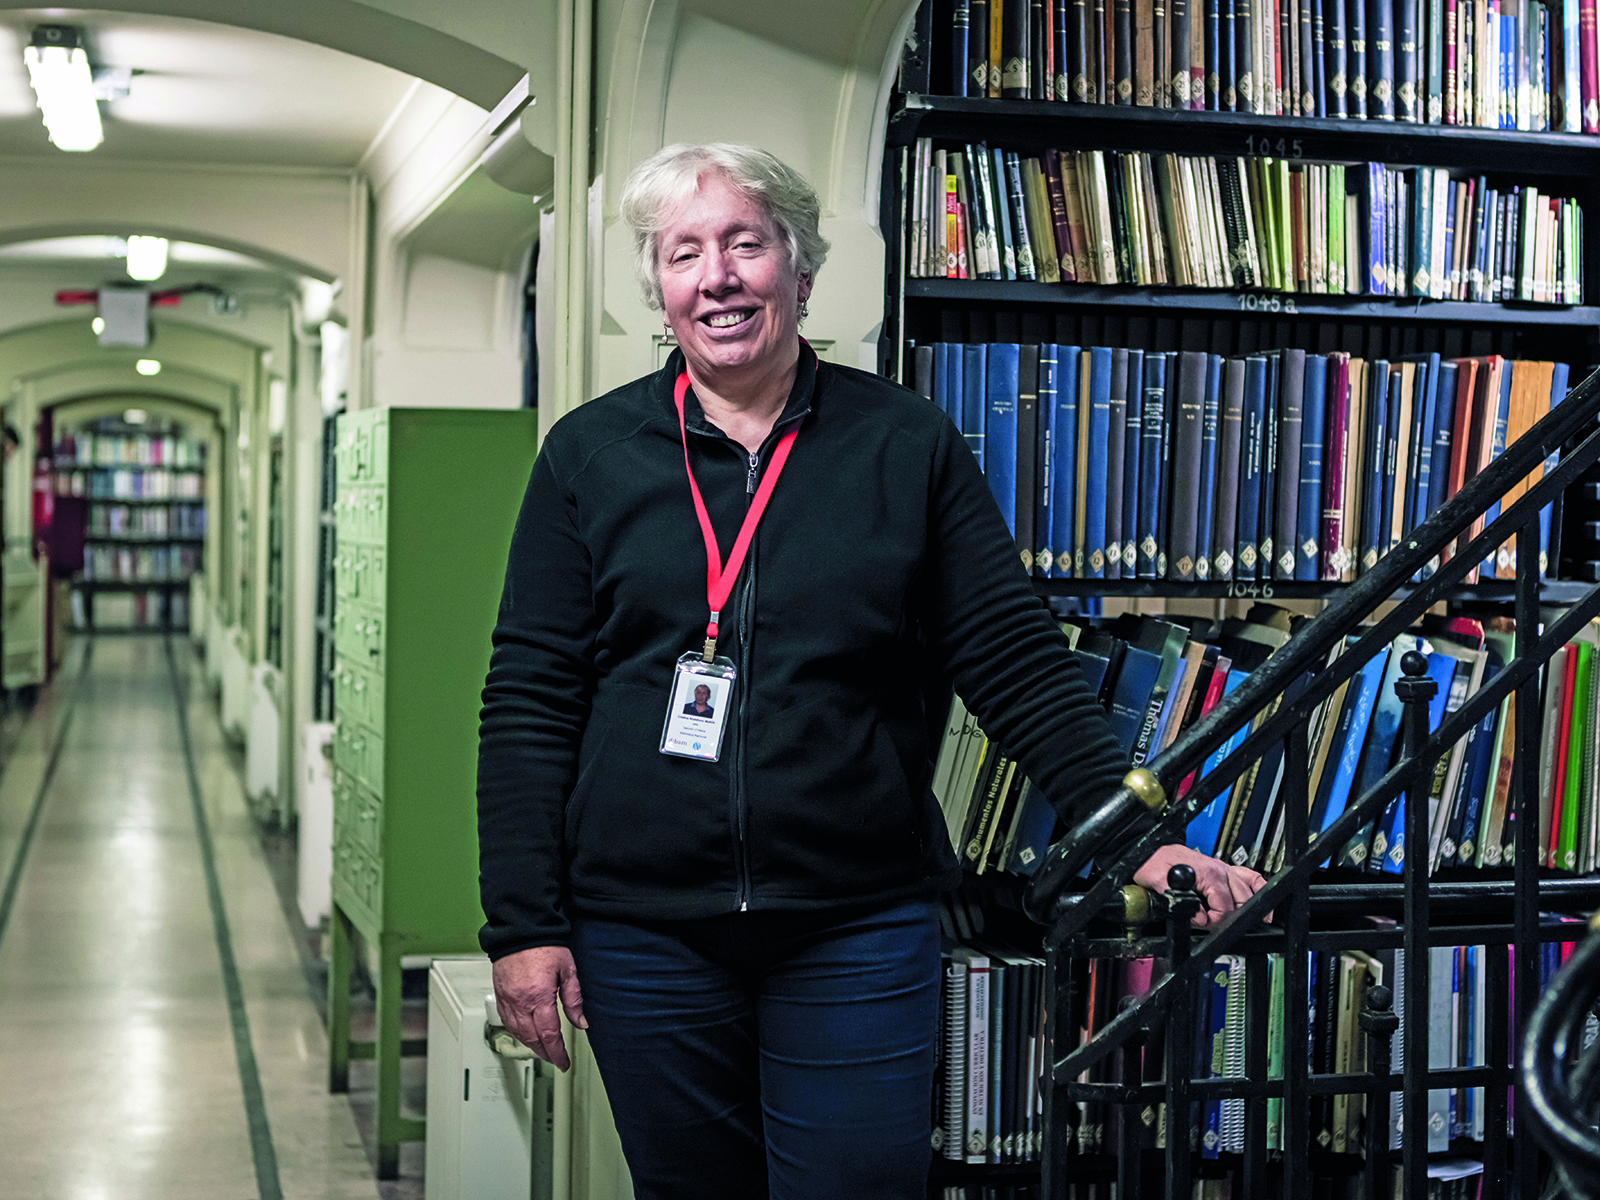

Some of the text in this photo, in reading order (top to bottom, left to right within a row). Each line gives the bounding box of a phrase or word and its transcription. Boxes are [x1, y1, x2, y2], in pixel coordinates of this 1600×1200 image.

[1246, 135, 1303, 157] 1045
[1227, 582, 1274, 599] 1046
[1137, 700, 1164, 750] Thomas
[987, 755, 1008, 799] Naturales
[1215, 971, 1228, 988] 4
